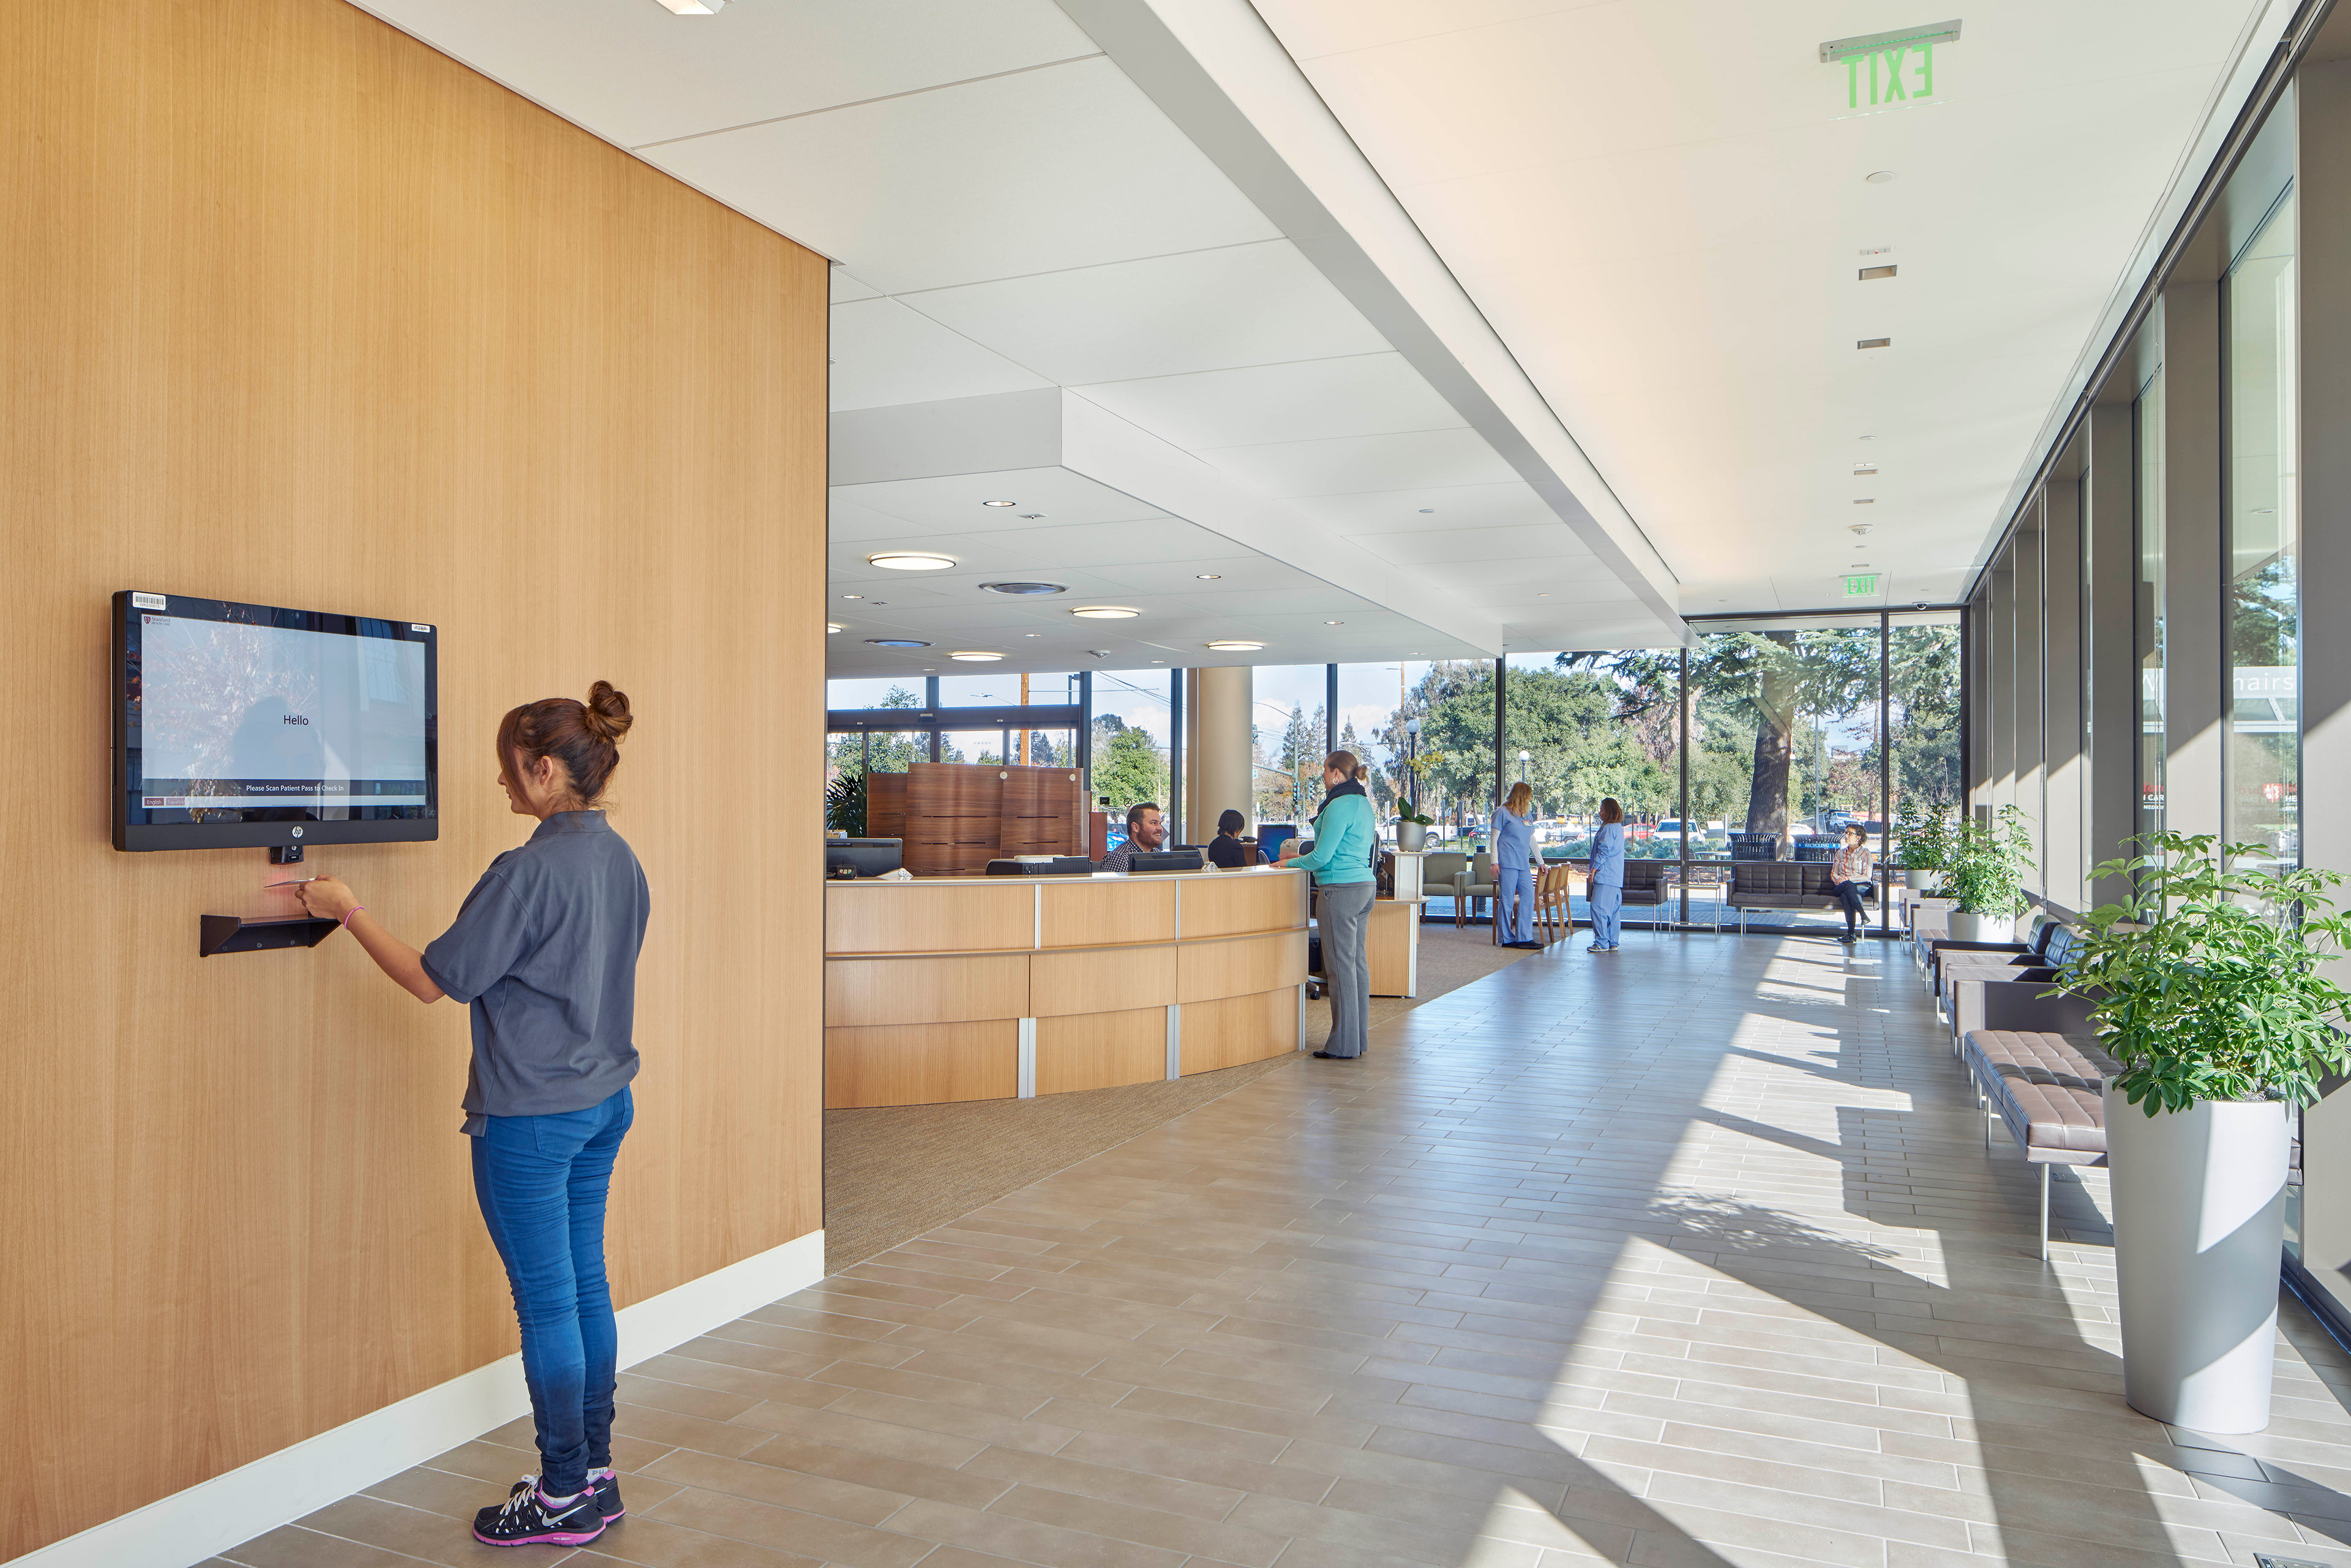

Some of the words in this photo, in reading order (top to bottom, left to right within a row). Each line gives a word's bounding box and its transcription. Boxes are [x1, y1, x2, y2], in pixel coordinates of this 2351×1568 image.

[1848, 576, 1876, 595] EXIT
[284, 715, 309, 725] Hello
[293, 826, 303, 838] hp
